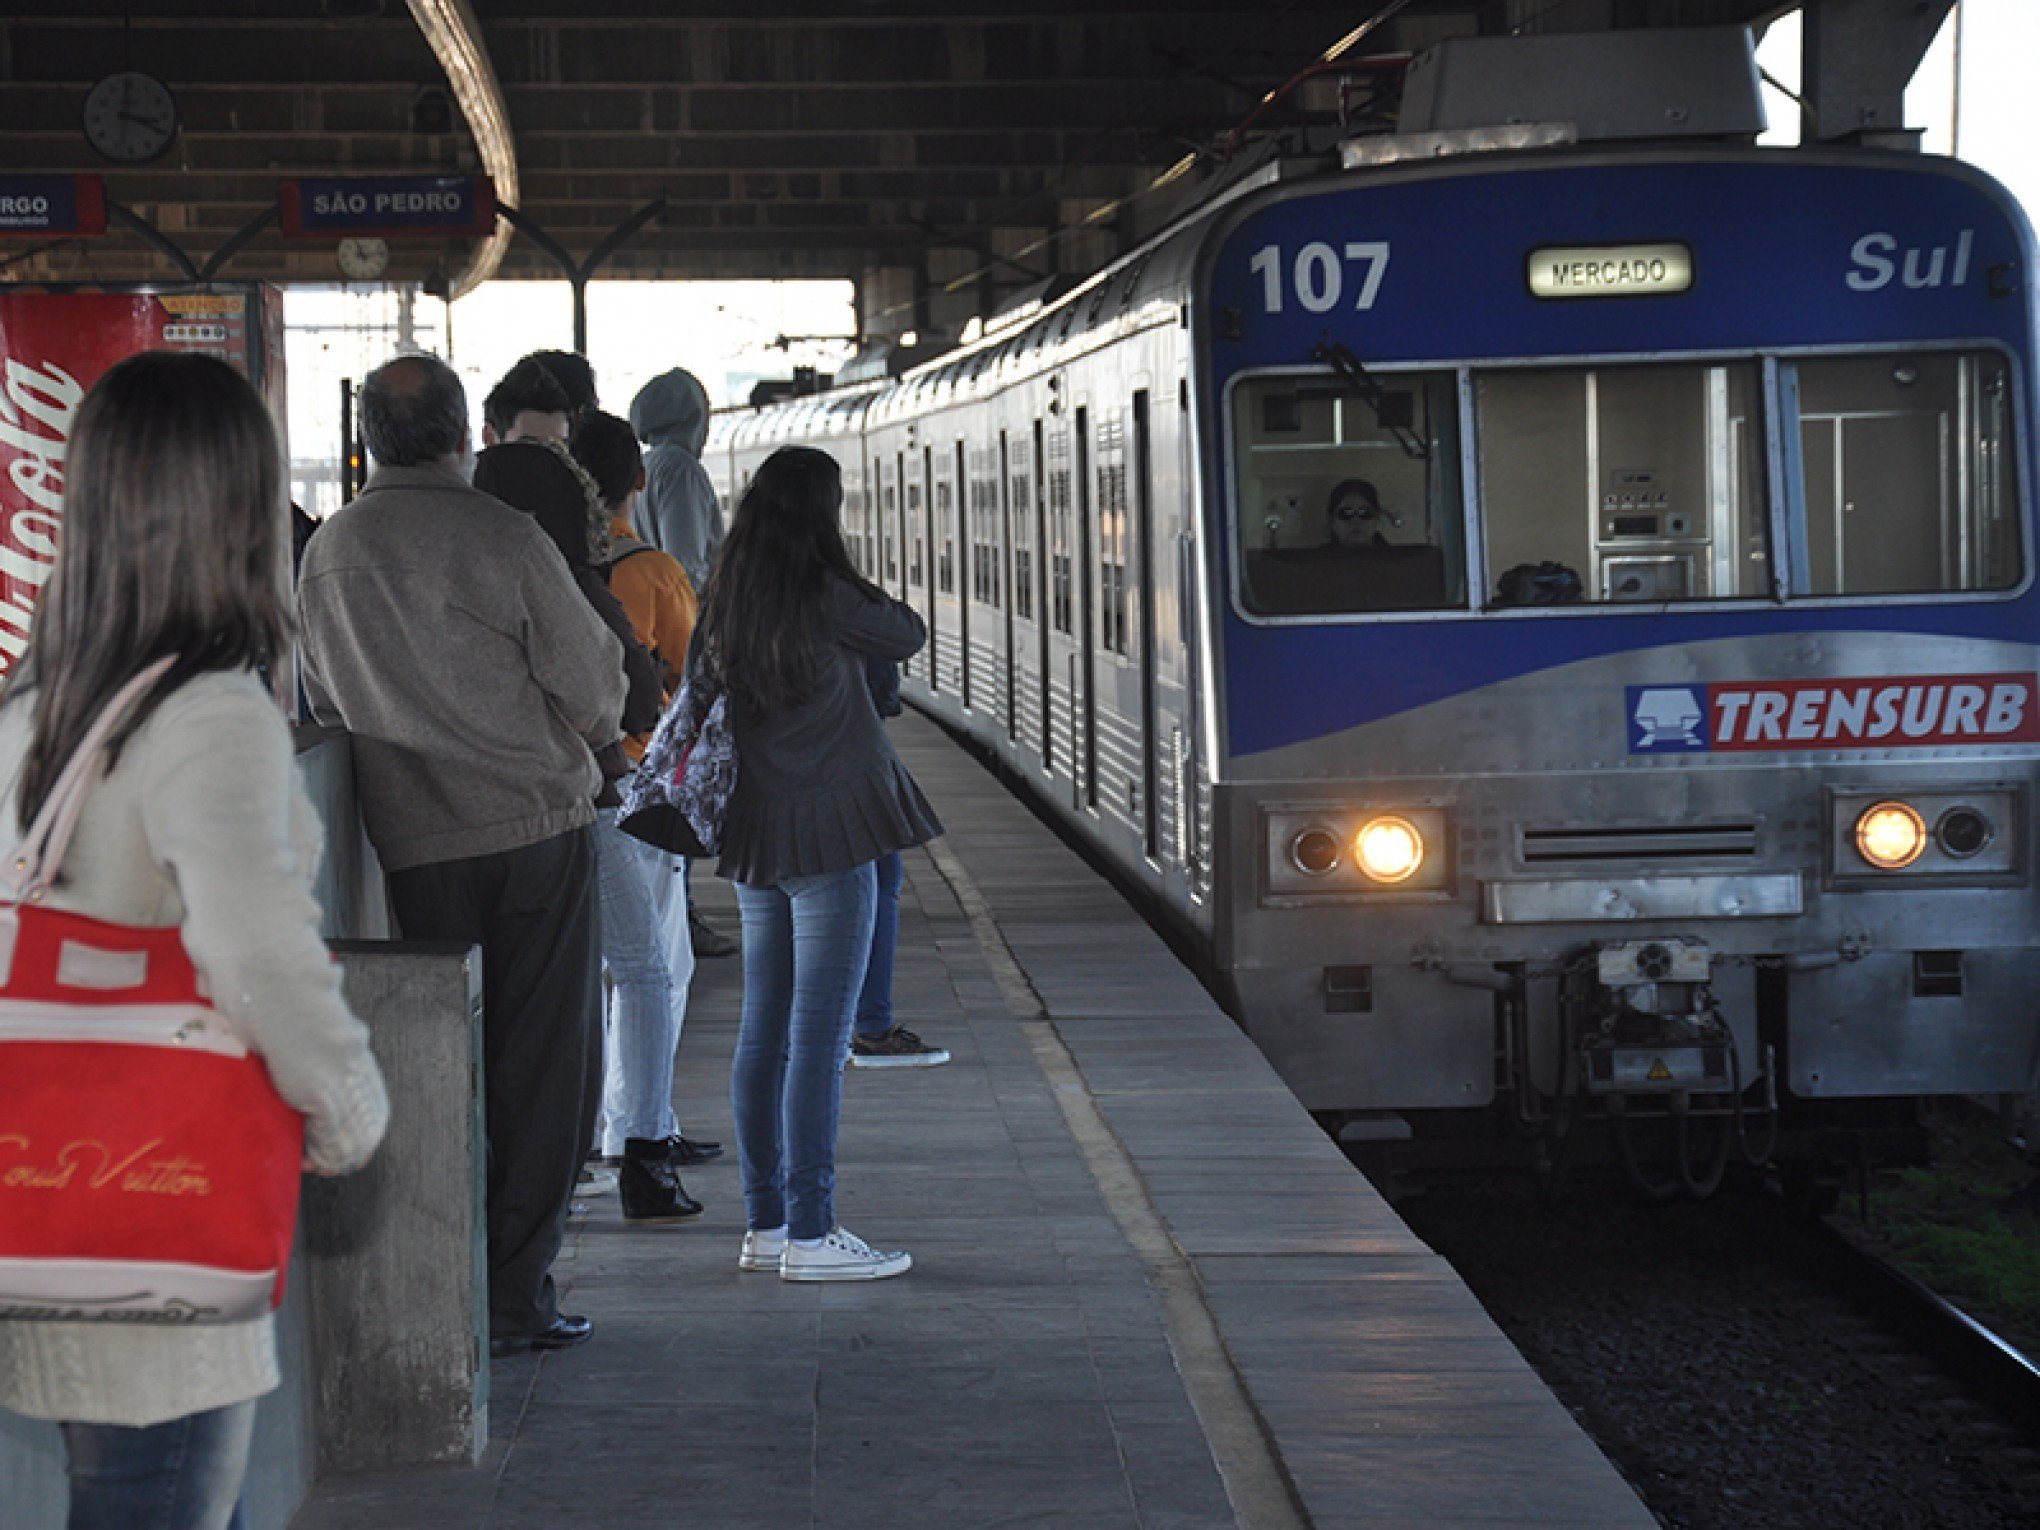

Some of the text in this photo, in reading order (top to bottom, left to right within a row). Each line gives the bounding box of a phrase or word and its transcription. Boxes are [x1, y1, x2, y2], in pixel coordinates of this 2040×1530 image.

[314, 191, 462, 214] SÃO PEDRO
[1250, 241, 1391, 313] 107
[1552, 257, 1666, 286] MERCADO
[1845, 229, 1974, 292] Sul
[1715, 683, 2028, 742] TRENSURB
